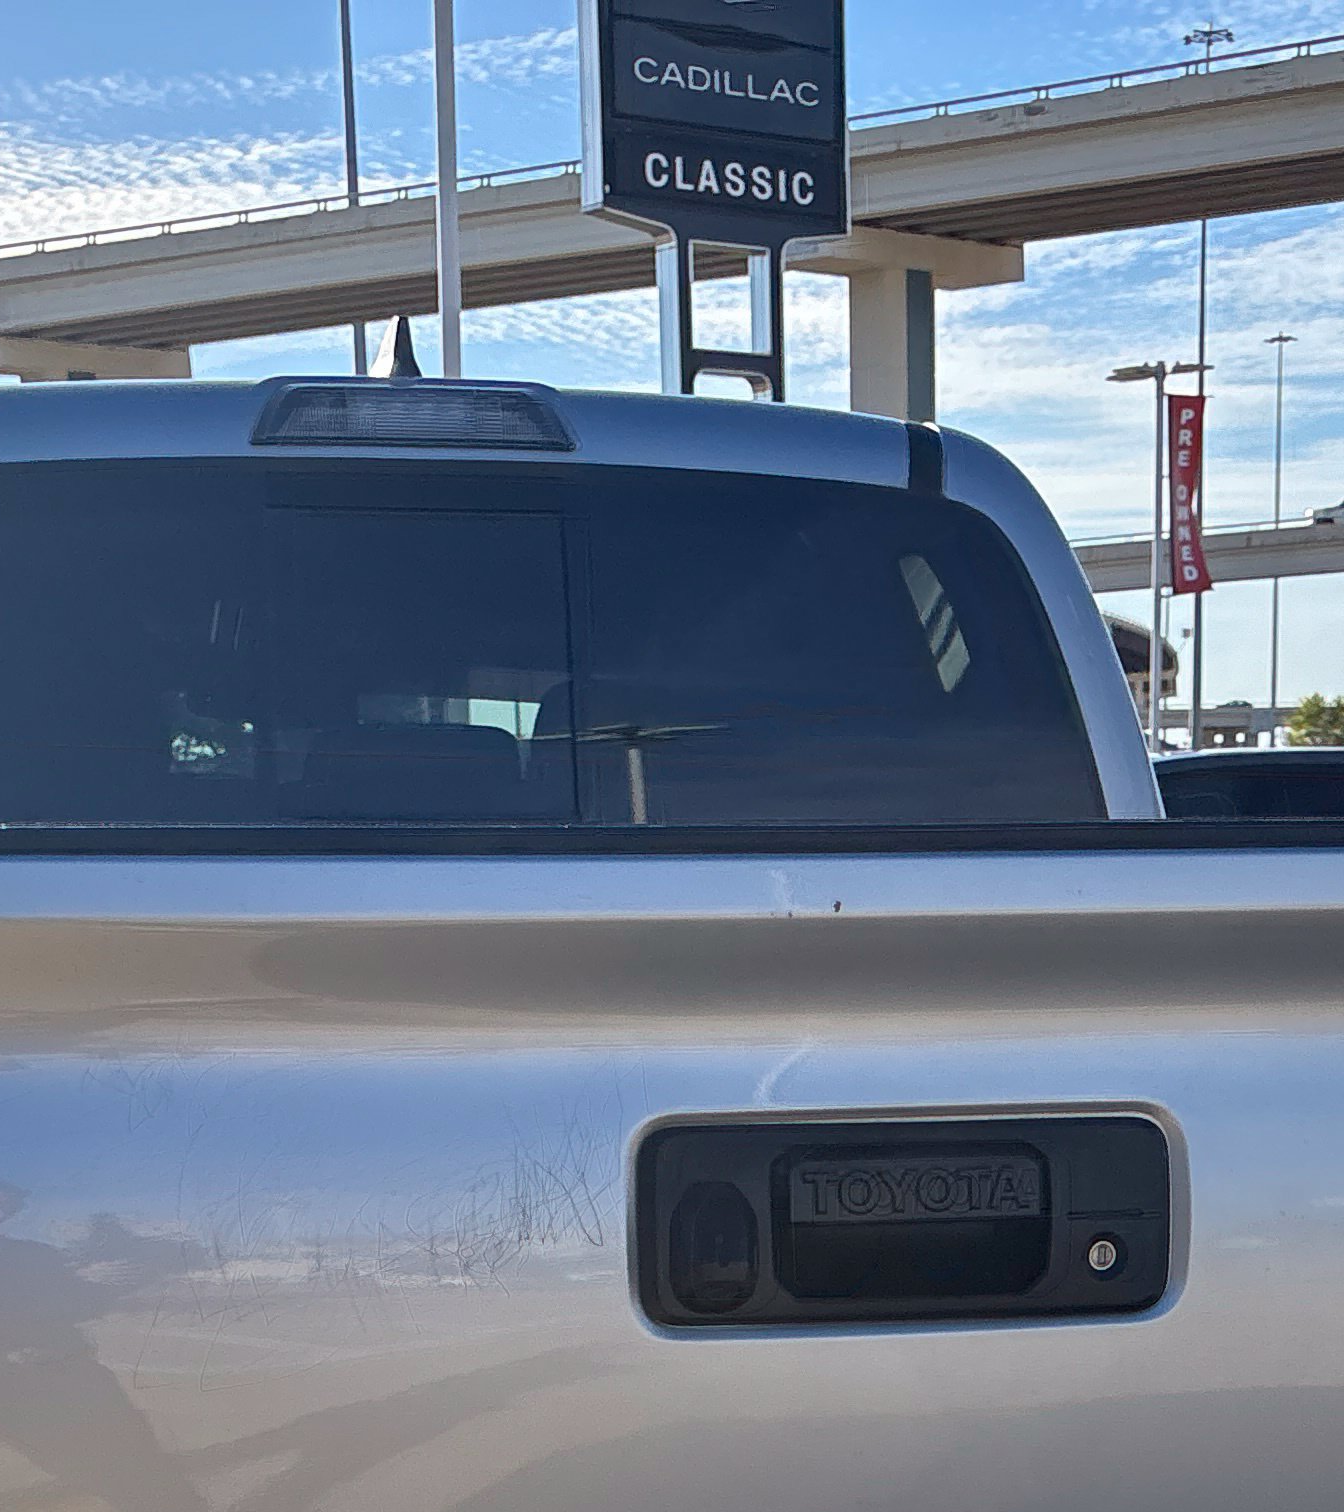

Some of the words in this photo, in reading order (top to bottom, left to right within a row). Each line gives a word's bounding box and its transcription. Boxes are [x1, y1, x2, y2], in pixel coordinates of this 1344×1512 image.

[633, 56, 820, 107] CADILLAC
[644, 152, 815, 206] CLASSIC
[1178, 408, 1196, 468] PRE
[1176, 484, 1200, 581] OWNED
[802, 1166, 1042, 1217] TOYOTA
